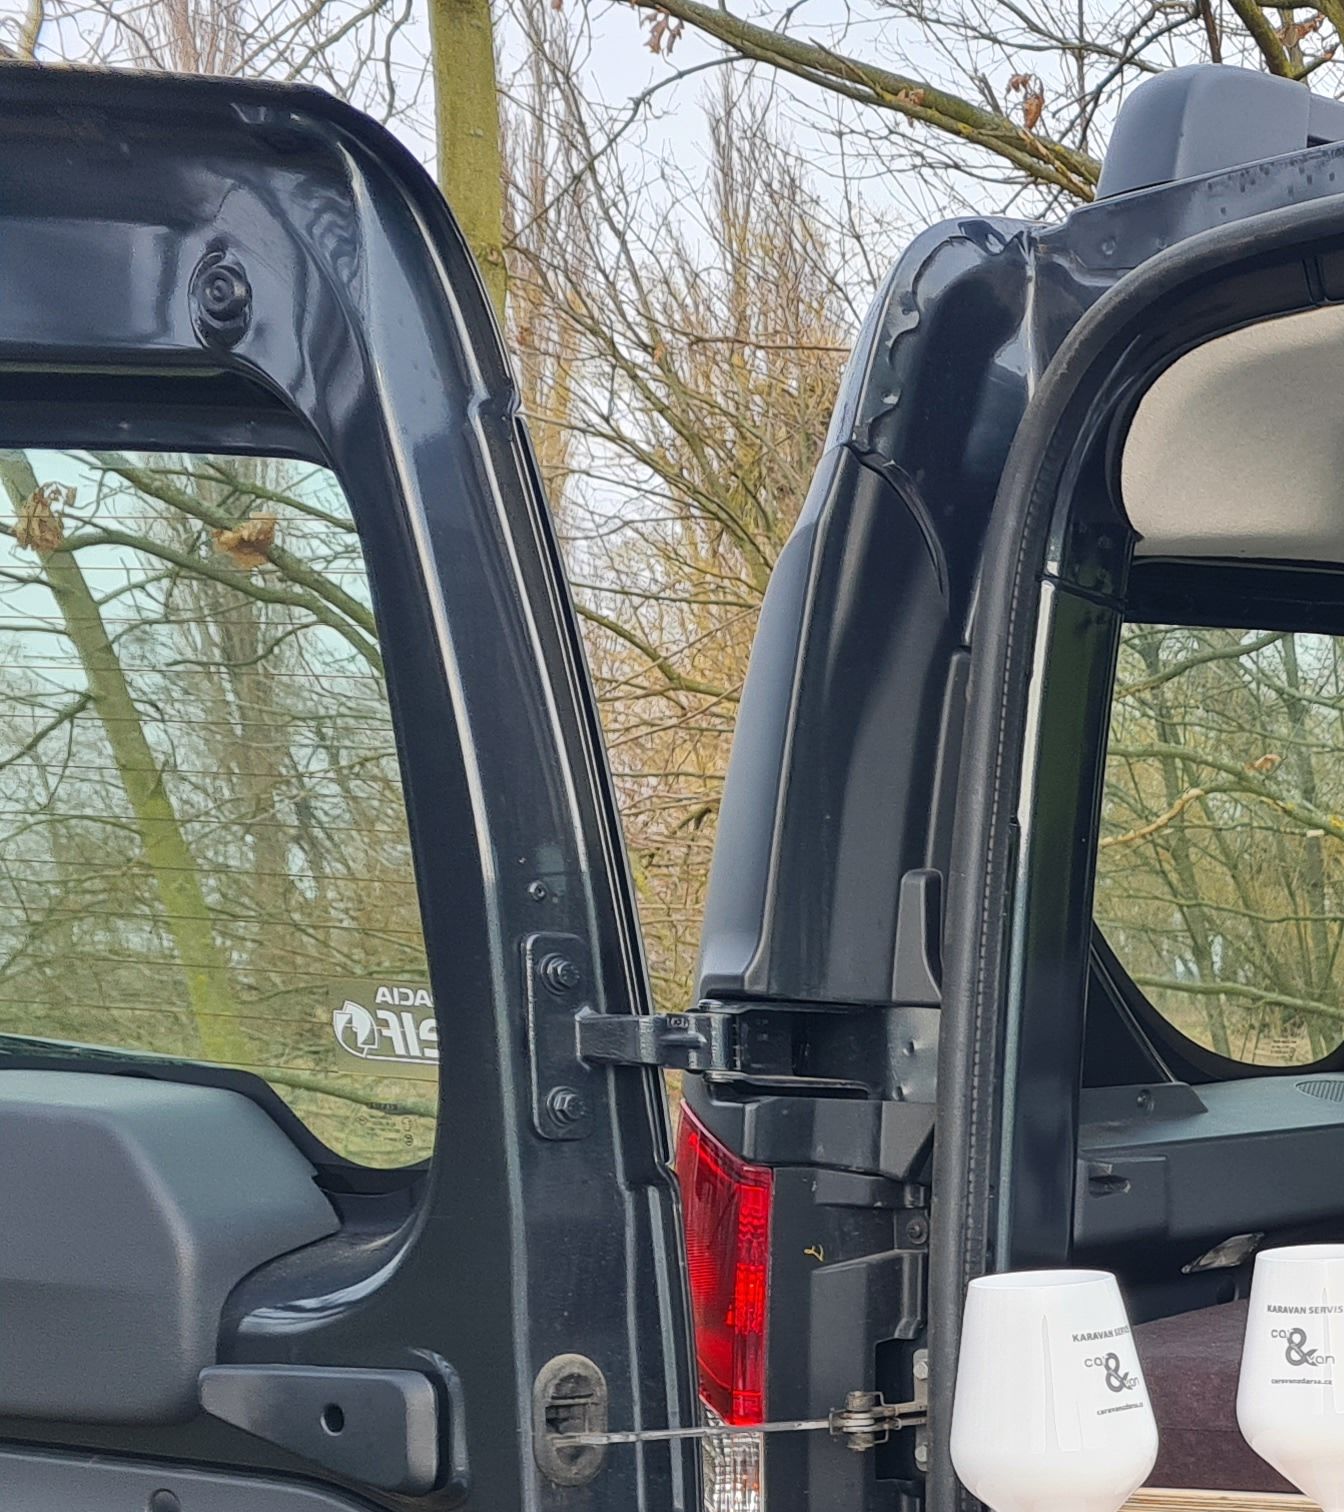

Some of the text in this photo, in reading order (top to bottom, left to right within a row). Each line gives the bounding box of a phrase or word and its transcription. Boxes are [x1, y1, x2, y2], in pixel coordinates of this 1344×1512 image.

[1266, 1304, 1344, 1315] KARAVAN SERVIS
[1071, 1329, 1114, 1342] KARAVAN
